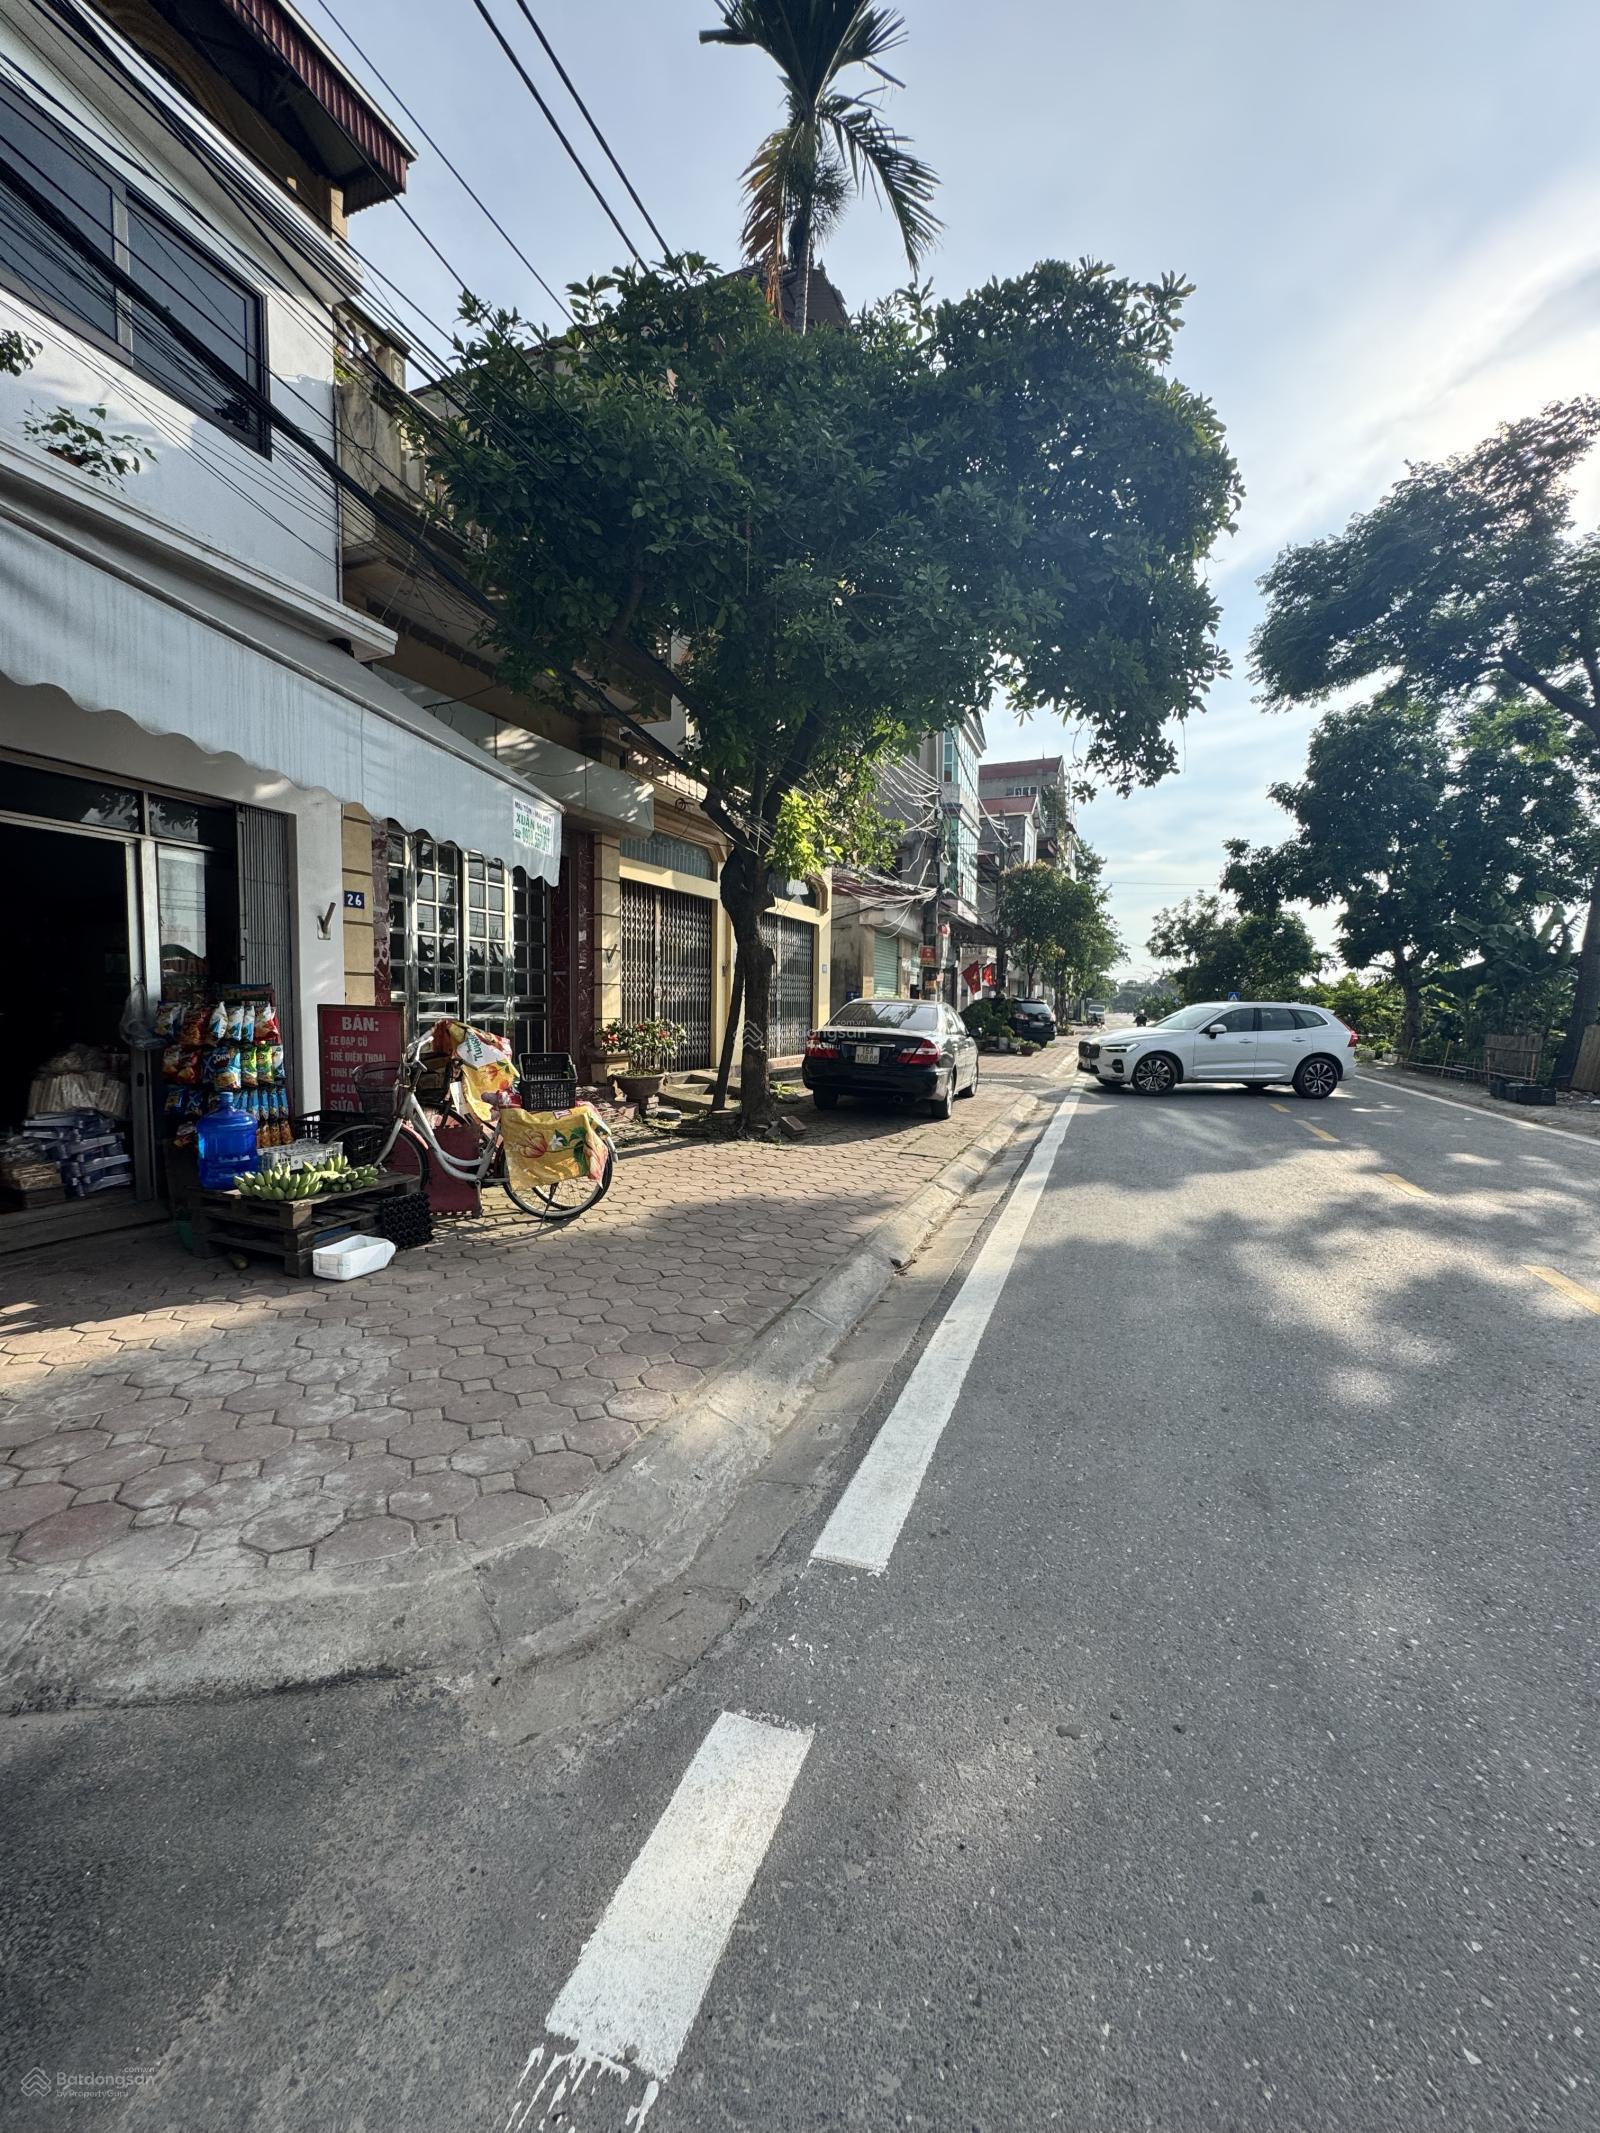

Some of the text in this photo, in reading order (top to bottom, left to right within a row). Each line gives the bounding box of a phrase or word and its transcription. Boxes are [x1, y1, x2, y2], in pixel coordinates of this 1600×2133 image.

[347, 893, 362, 906] 26
[342, 1013, 379, 1032] BÁN:
[329, 1036, 339, 1046] XE
